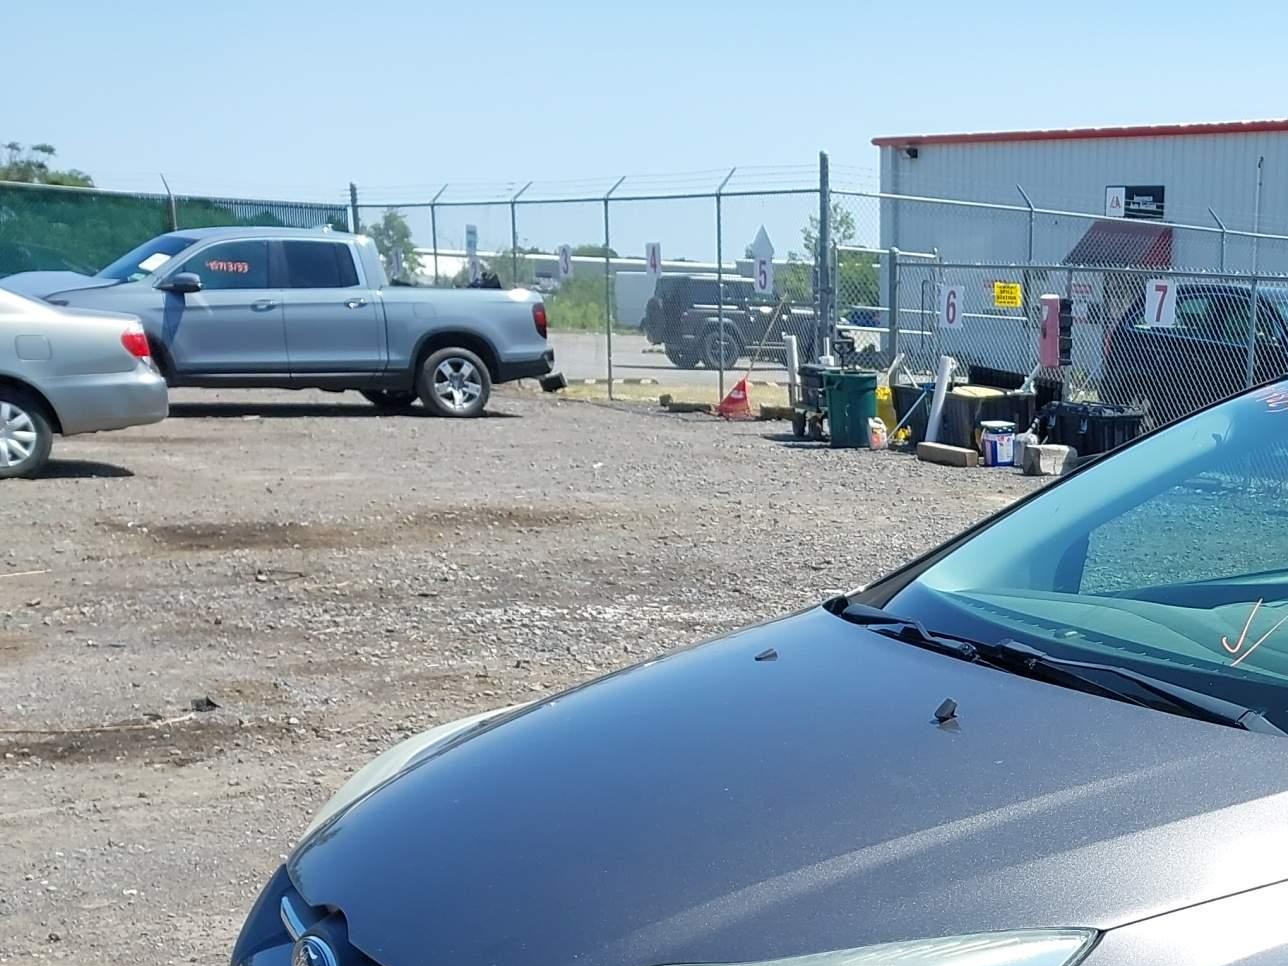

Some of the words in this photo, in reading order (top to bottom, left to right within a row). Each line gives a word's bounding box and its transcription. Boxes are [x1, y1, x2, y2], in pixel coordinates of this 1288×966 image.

[562, 248, 569, 274] 3
[650, 245, 657, 273] 4
[759, 260, 767, 290] 5
[945, 290, 957, 324] 6
[1155, 284, 1168, 322] 7
